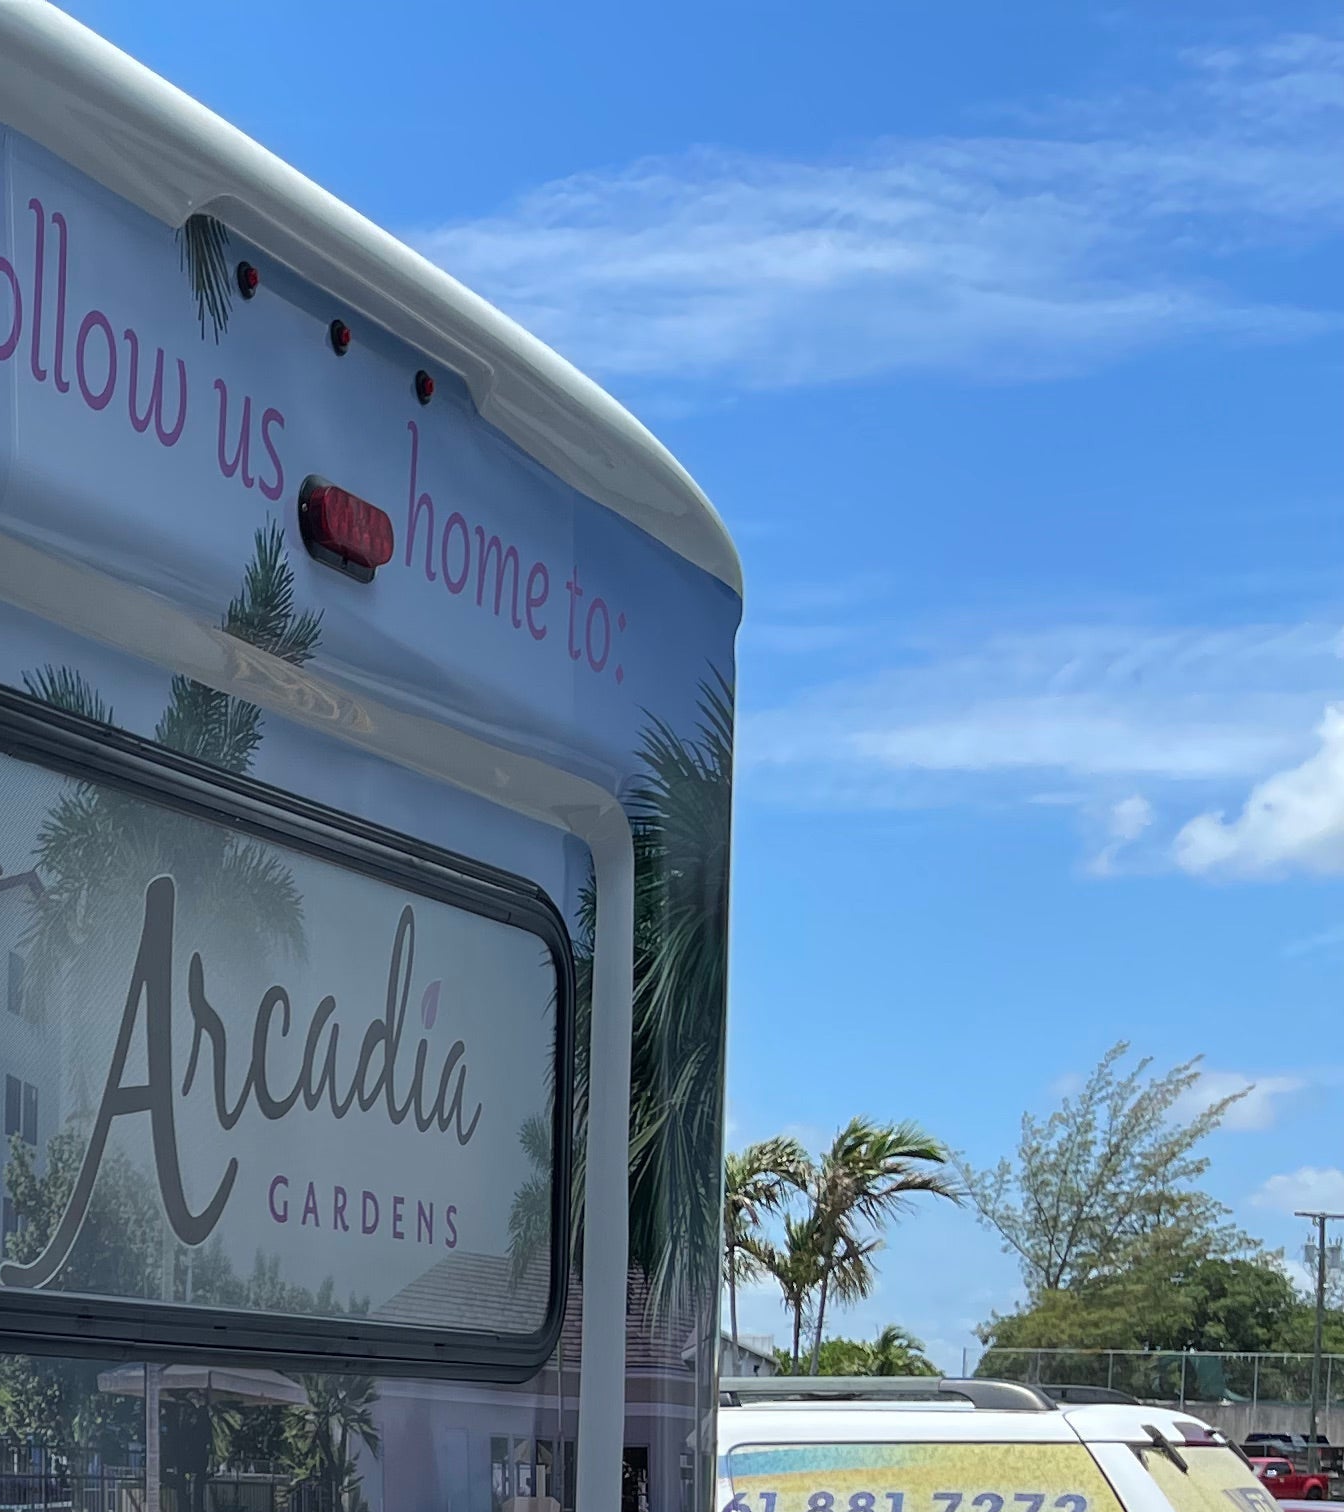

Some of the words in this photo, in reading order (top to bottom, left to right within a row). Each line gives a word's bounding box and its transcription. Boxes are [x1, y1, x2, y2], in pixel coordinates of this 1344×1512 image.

[214, 379, 284, 501] us
[405, 421, 549, 641] home
[566, 564, 628, 684] to:
[268, 1175, 459, 1249] GARDENS
